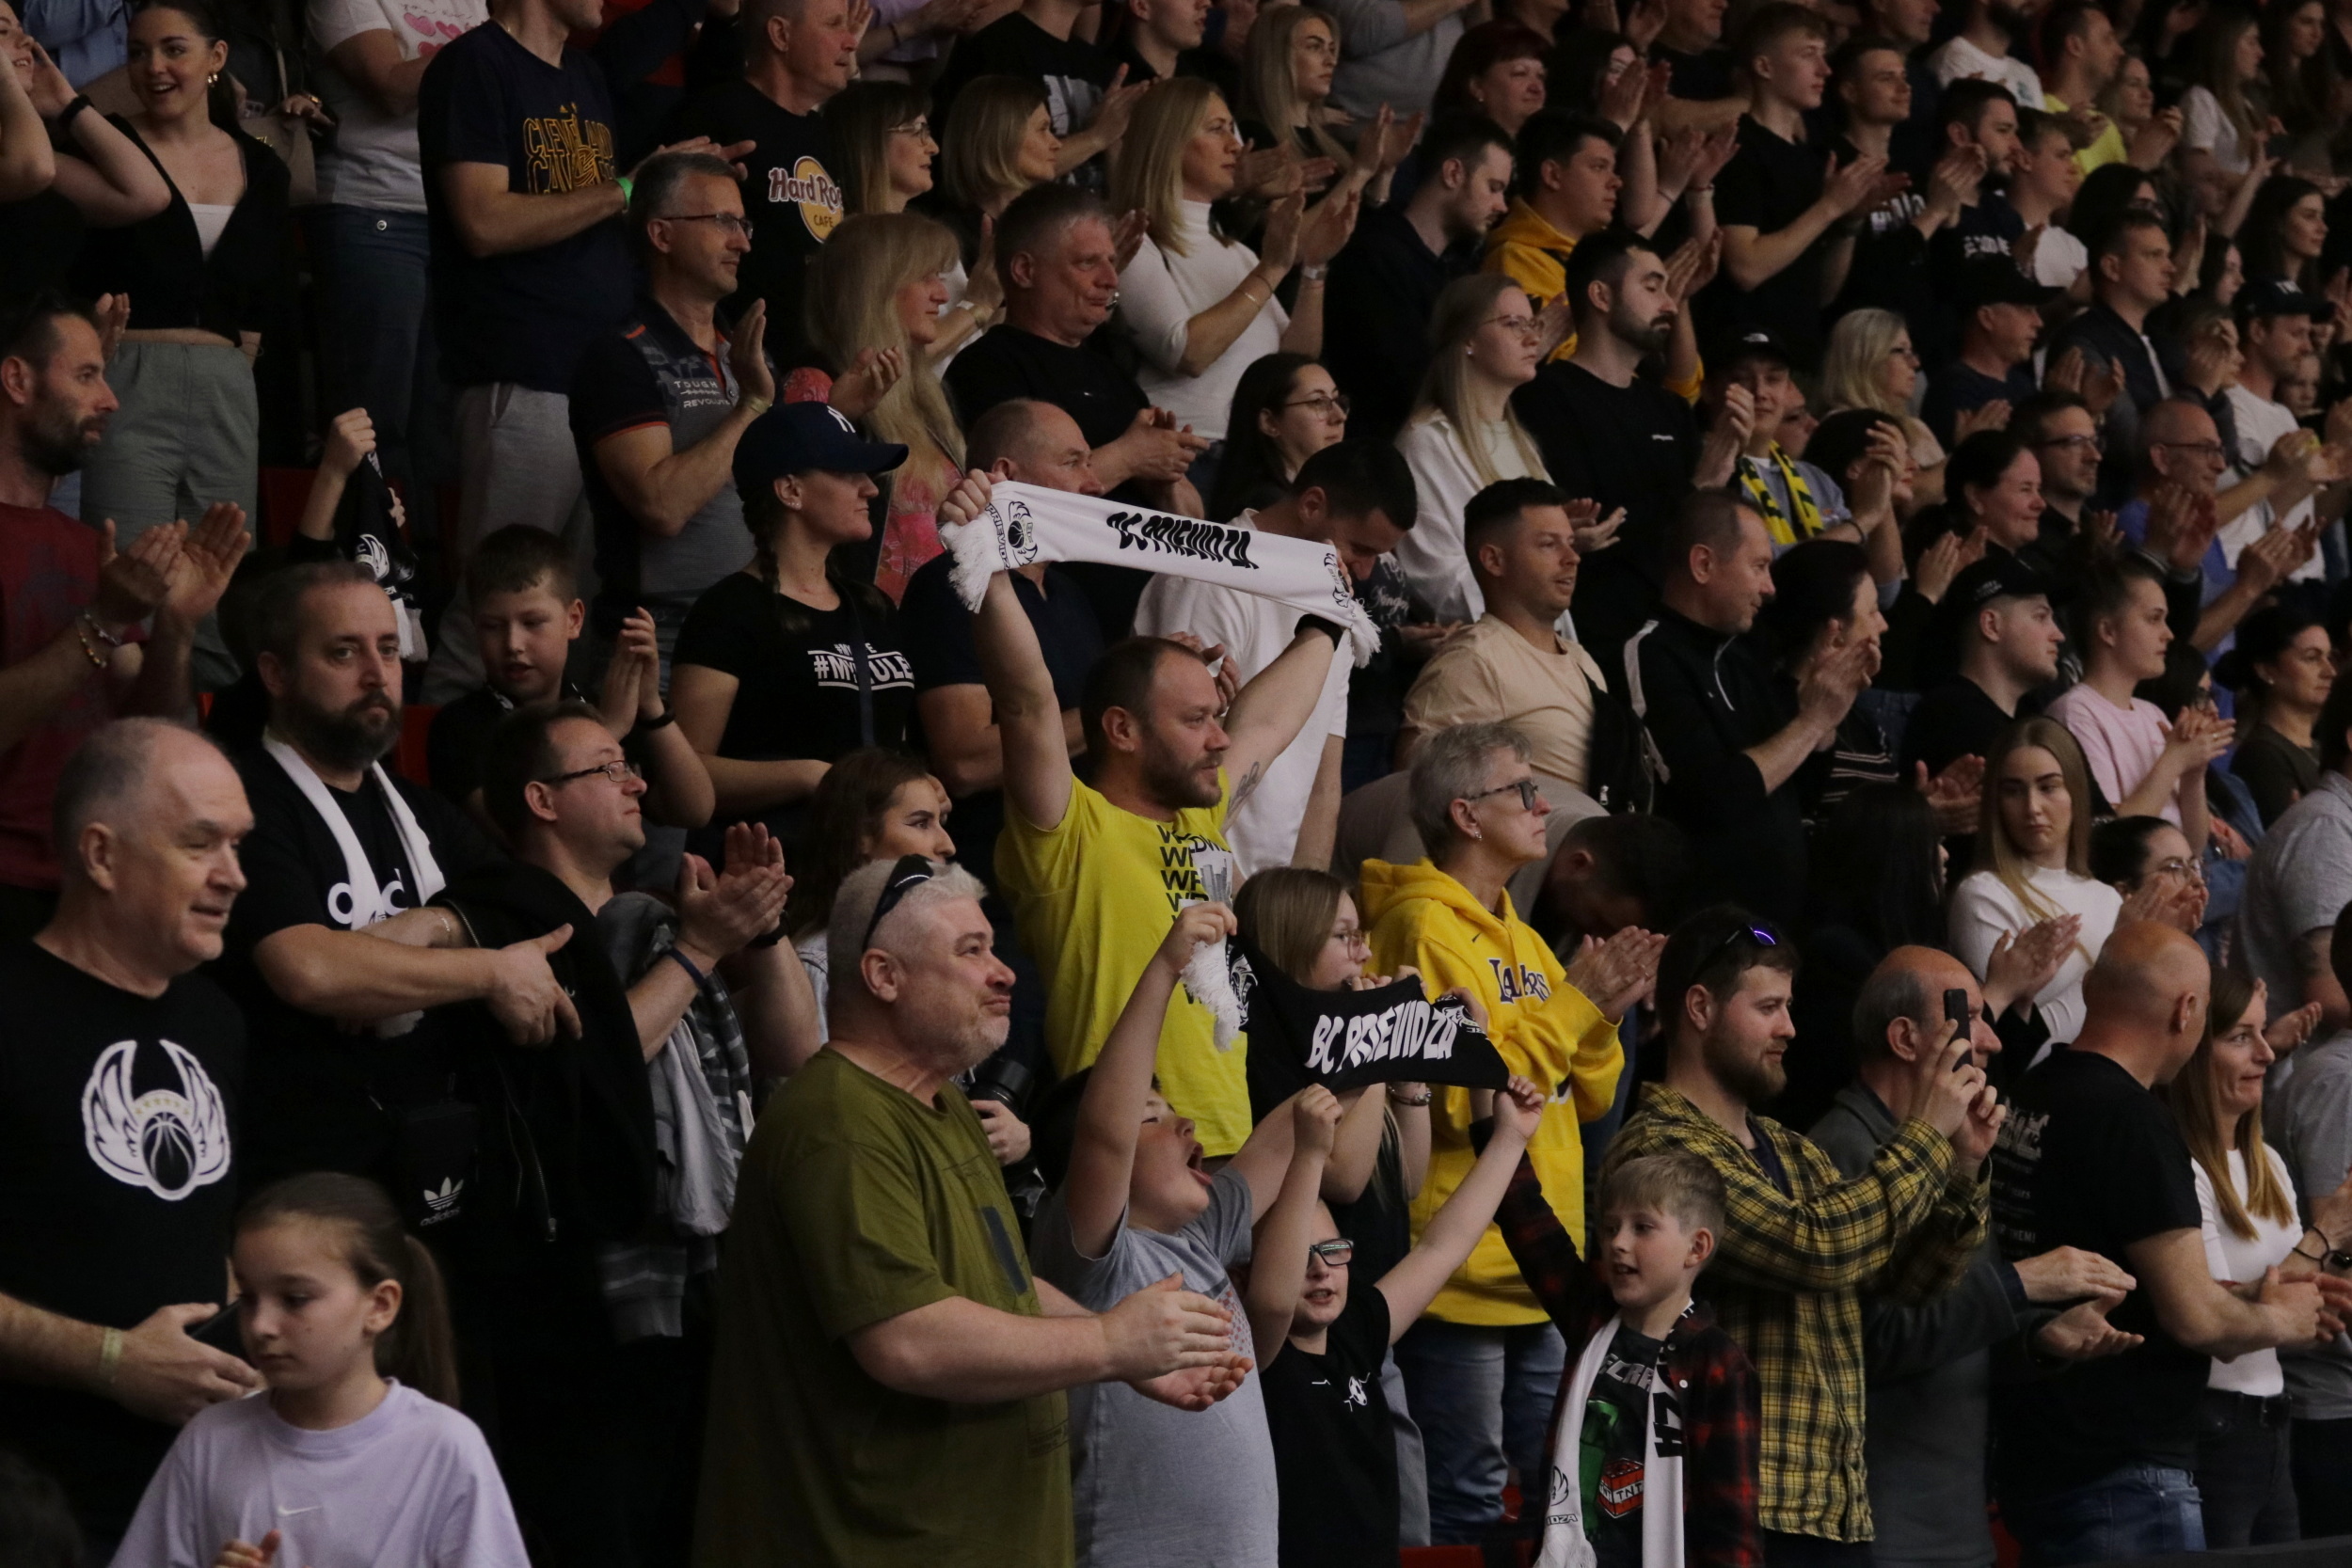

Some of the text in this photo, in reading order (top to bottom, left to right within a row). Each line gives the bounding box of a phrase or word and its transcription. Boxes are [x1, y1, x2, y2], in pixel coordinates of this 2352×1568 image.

[769, 167, 843, 214] Hard Ro
[813, 214, 834, 227] CAFE
[674, 380, 718, 388] TOUGH
[984, 501, 1010, 571] PRIEVIDZ
[1303, 998, 1458, 1075] BC PRIEVIDZA
[1616, 1482, 1643, 1500] TNT
